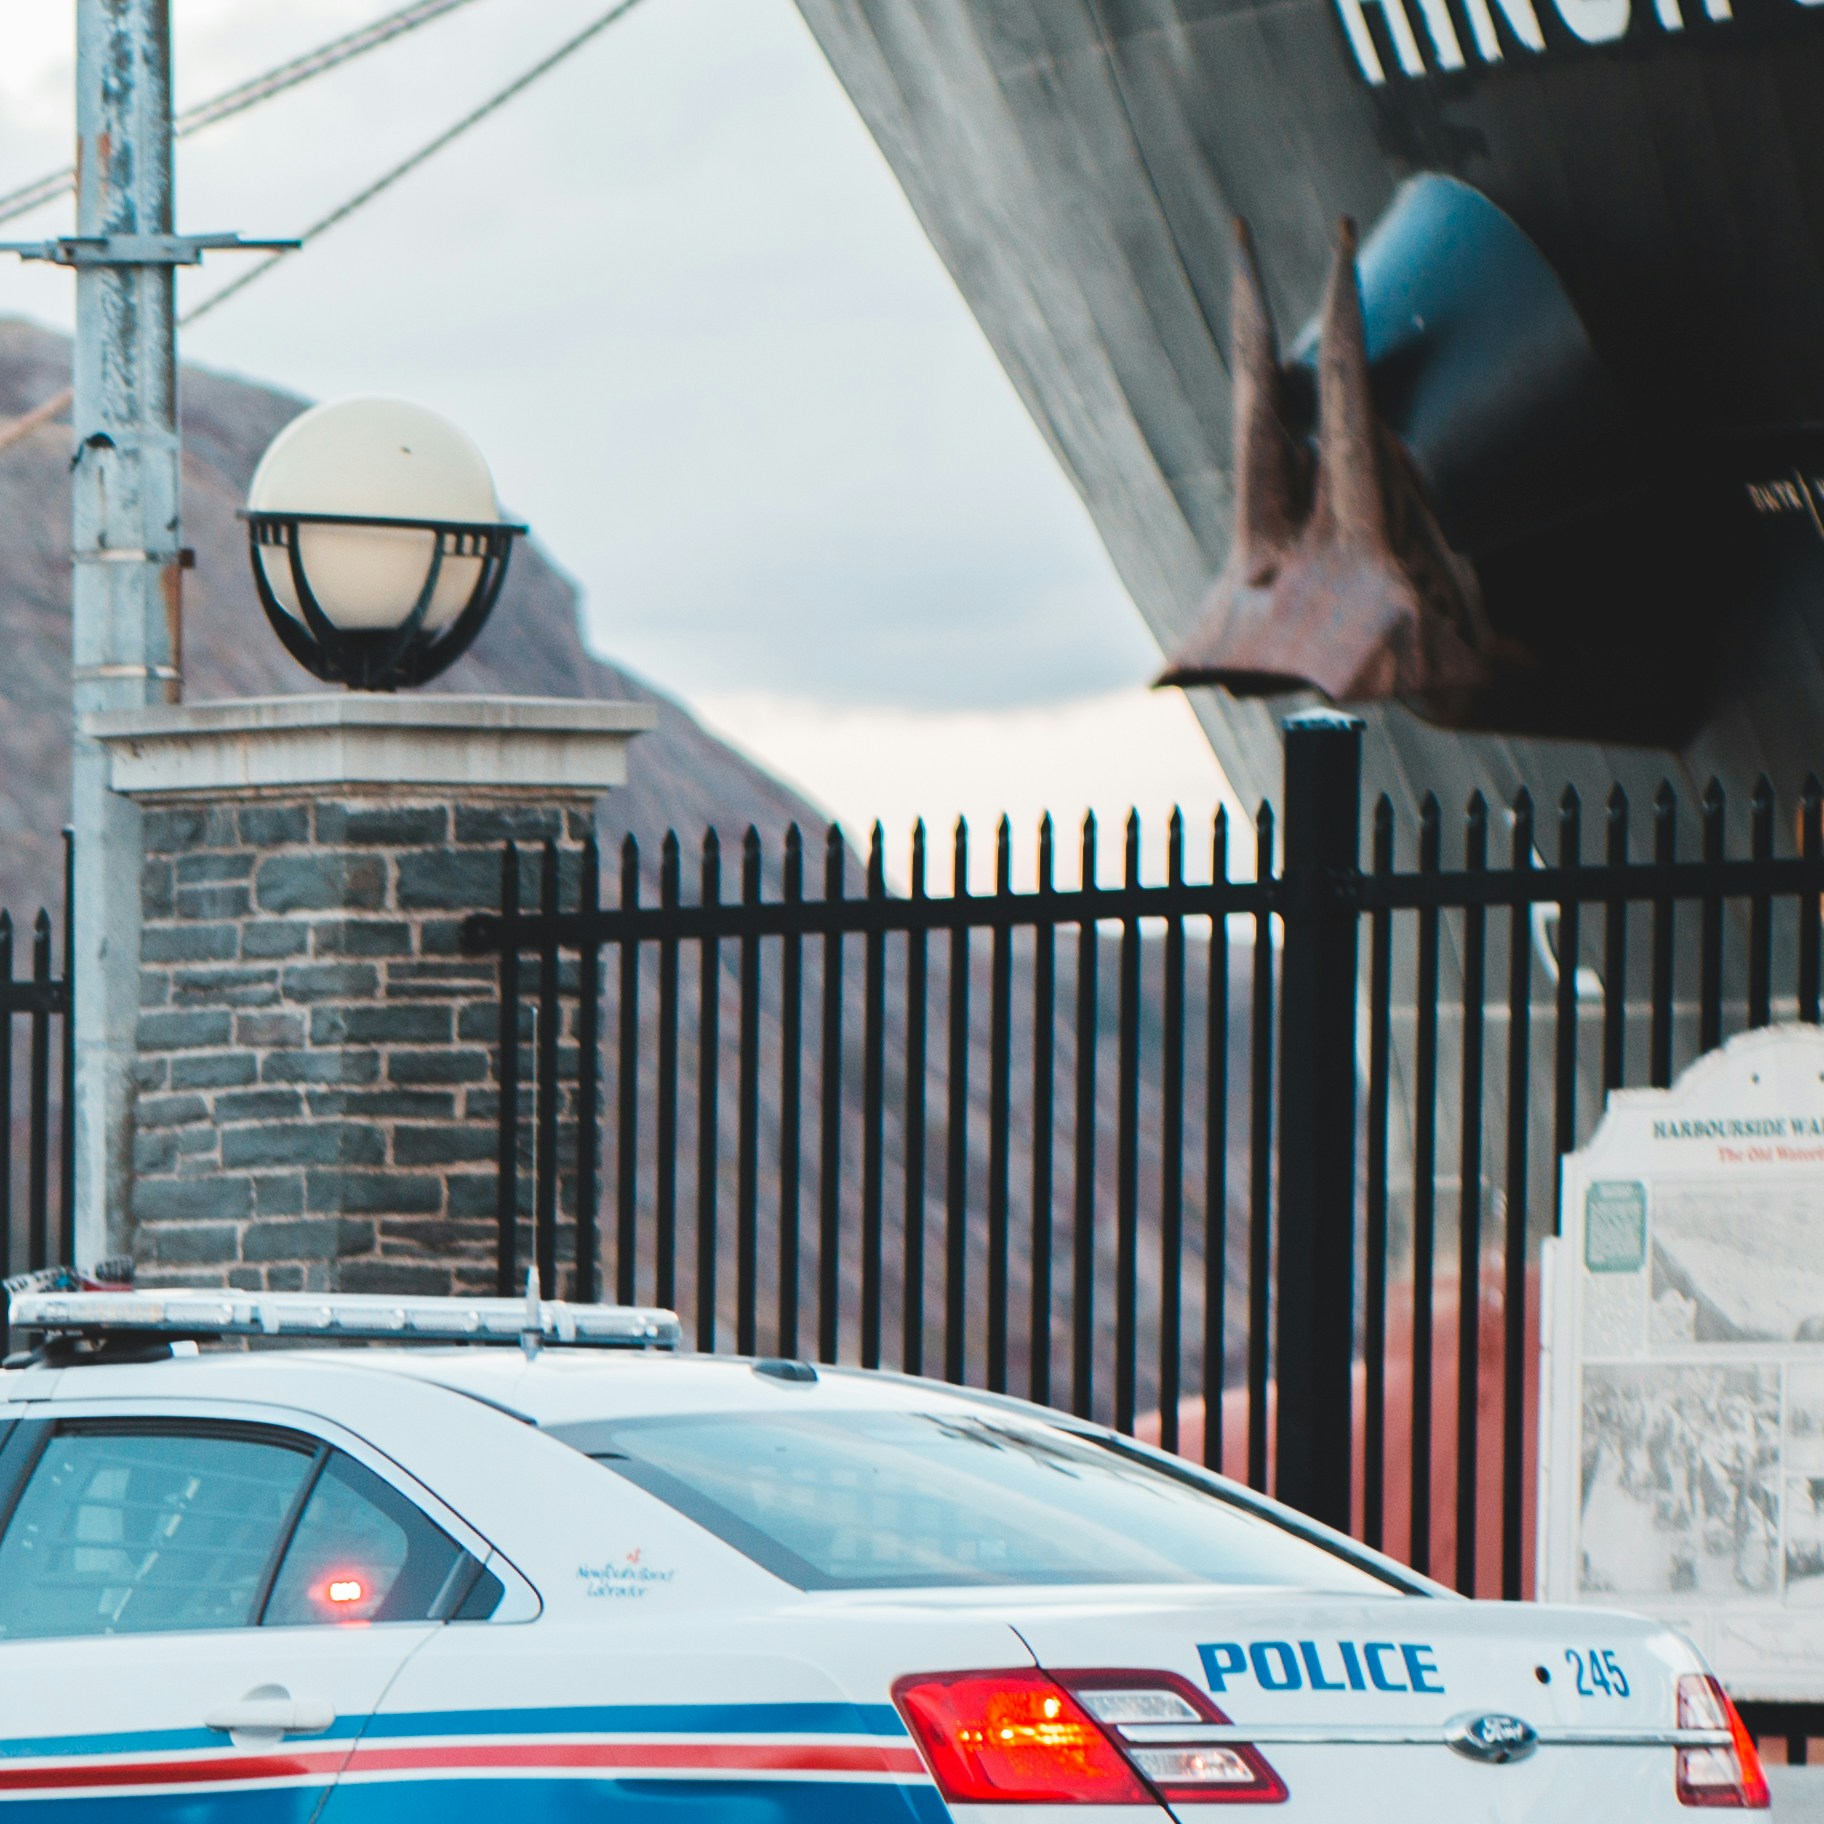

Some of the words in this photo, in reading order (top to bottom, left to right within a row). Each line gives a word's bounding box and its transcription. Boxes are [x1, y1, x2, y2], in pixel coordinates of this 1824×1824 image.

[1653, 1118, 1786, 1138] HARBOURSIDE
[1196, 1641, 1445, 1694] POLICE
[1566, 1649, 1631, 1698] 245
